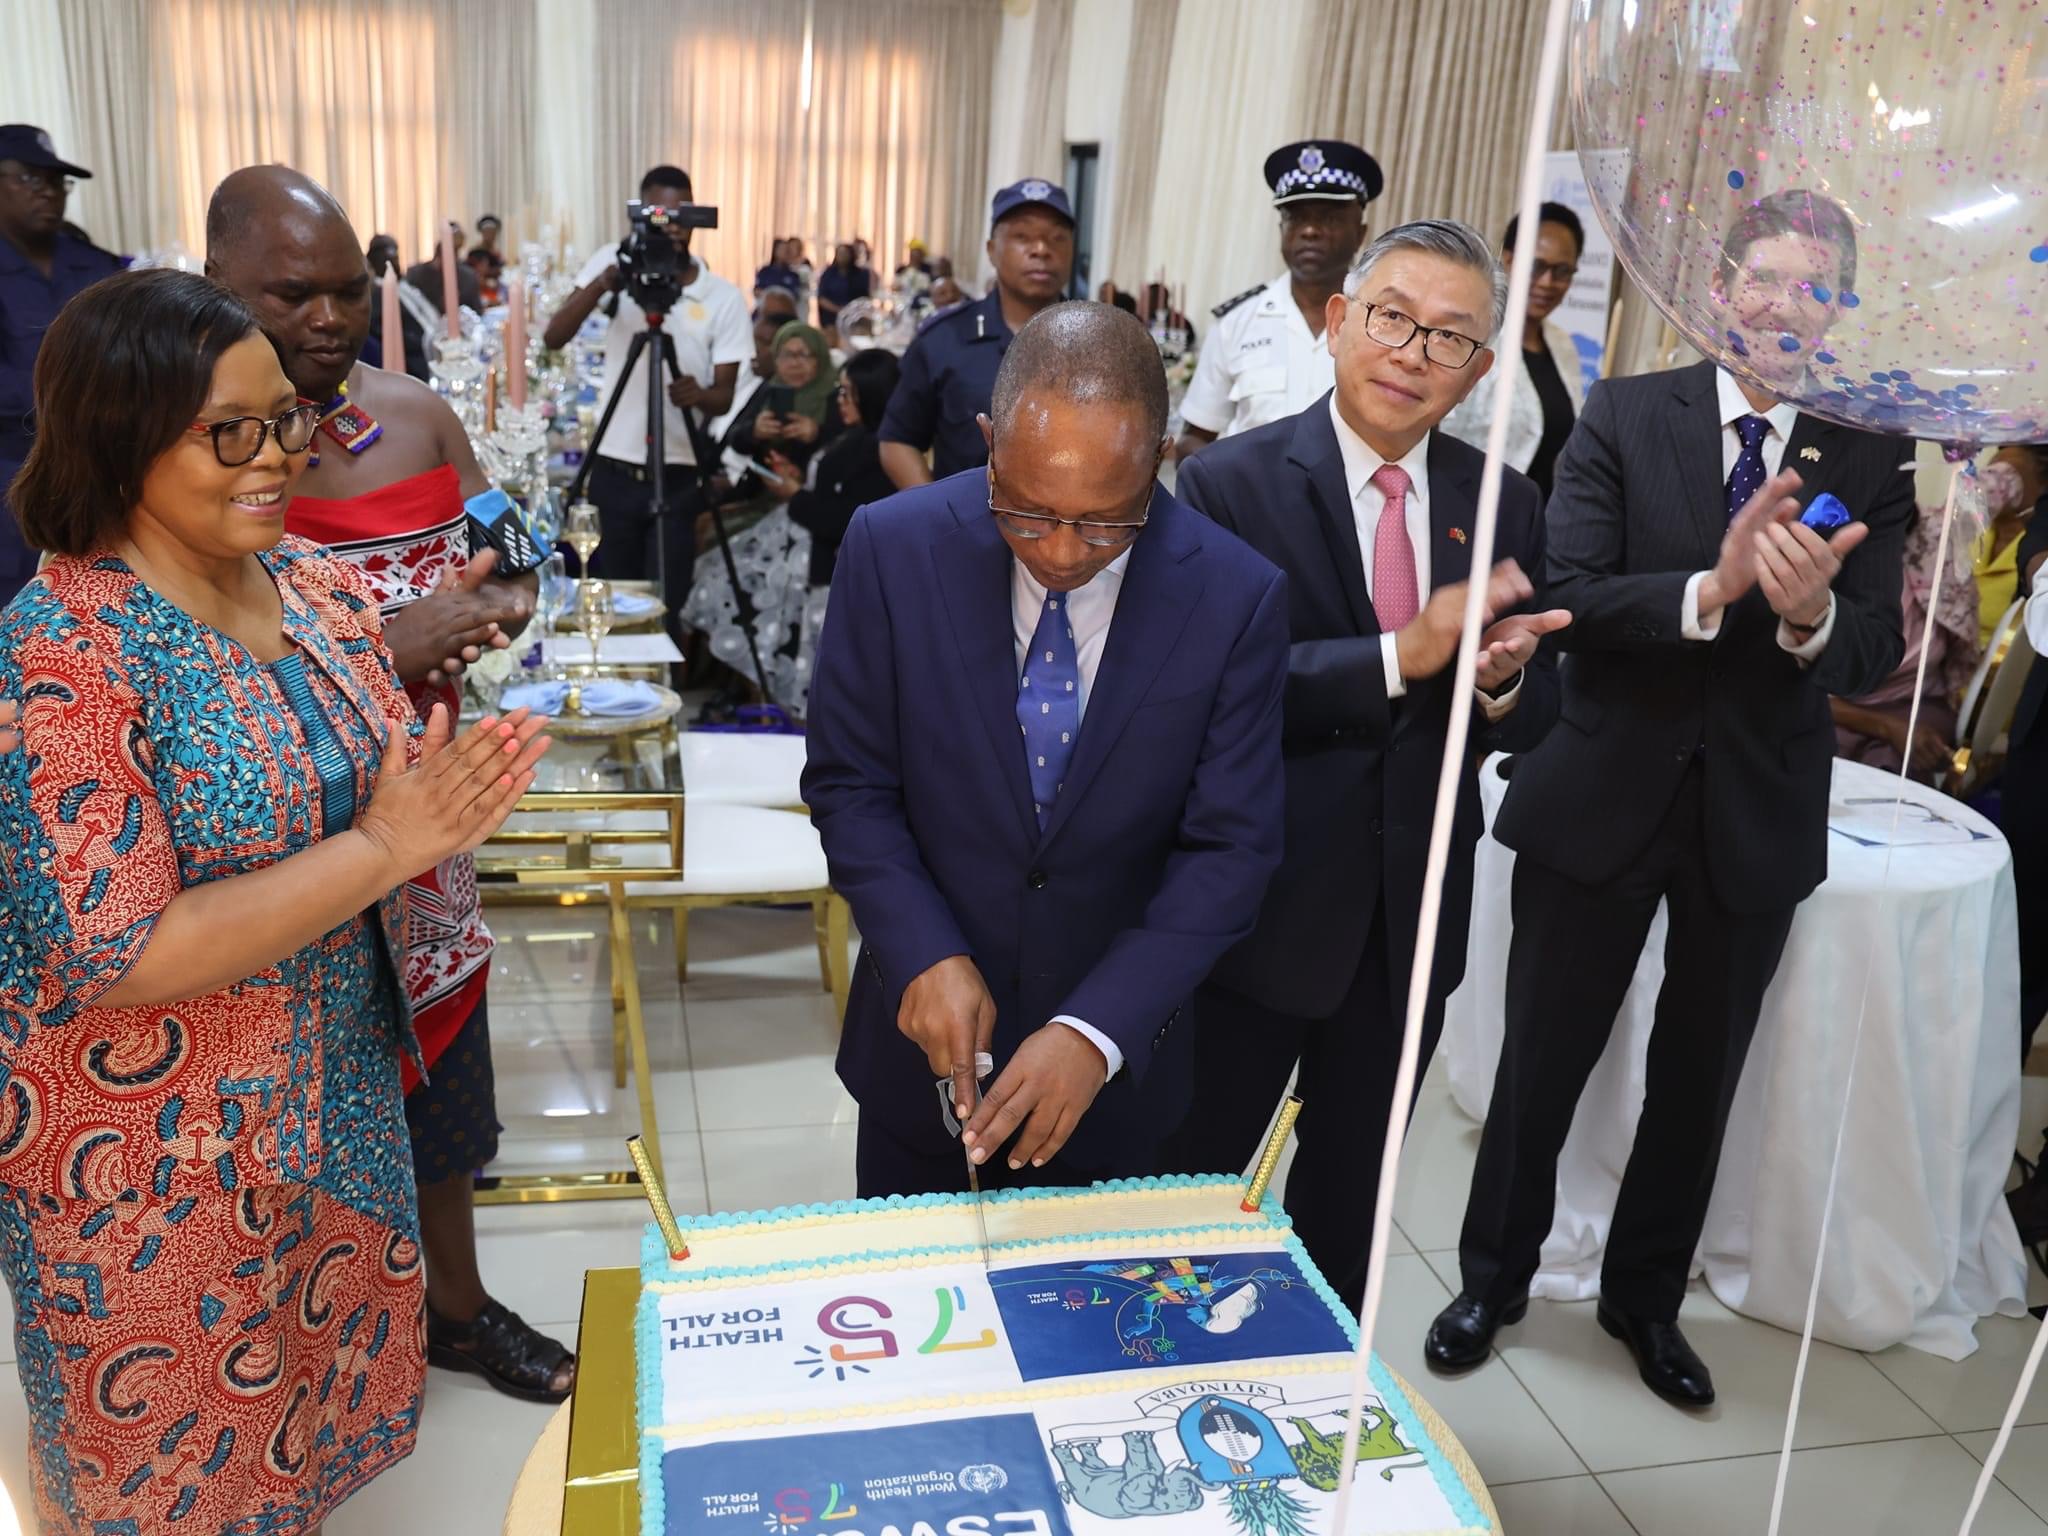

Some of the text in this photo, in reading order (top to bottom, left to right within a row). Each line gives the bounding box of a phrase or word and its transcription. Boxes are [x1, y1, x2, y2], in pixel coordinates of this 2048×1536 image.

[1030, 1296, 1059, 1305] HEALTH
[662, 1307, 781, 1331] FOR ALL
[670, 1328, 784, 1351] HEALTH
[1149, 1383, 1269, 1403] SIYINQABA
[864, 1470, 954, 1489] Organization
[702, 1492, 758, 1506] FOR ALL
[866, 1482, 957, 1501] World Health
[706, 1504, 760, 1517] HEALTH
